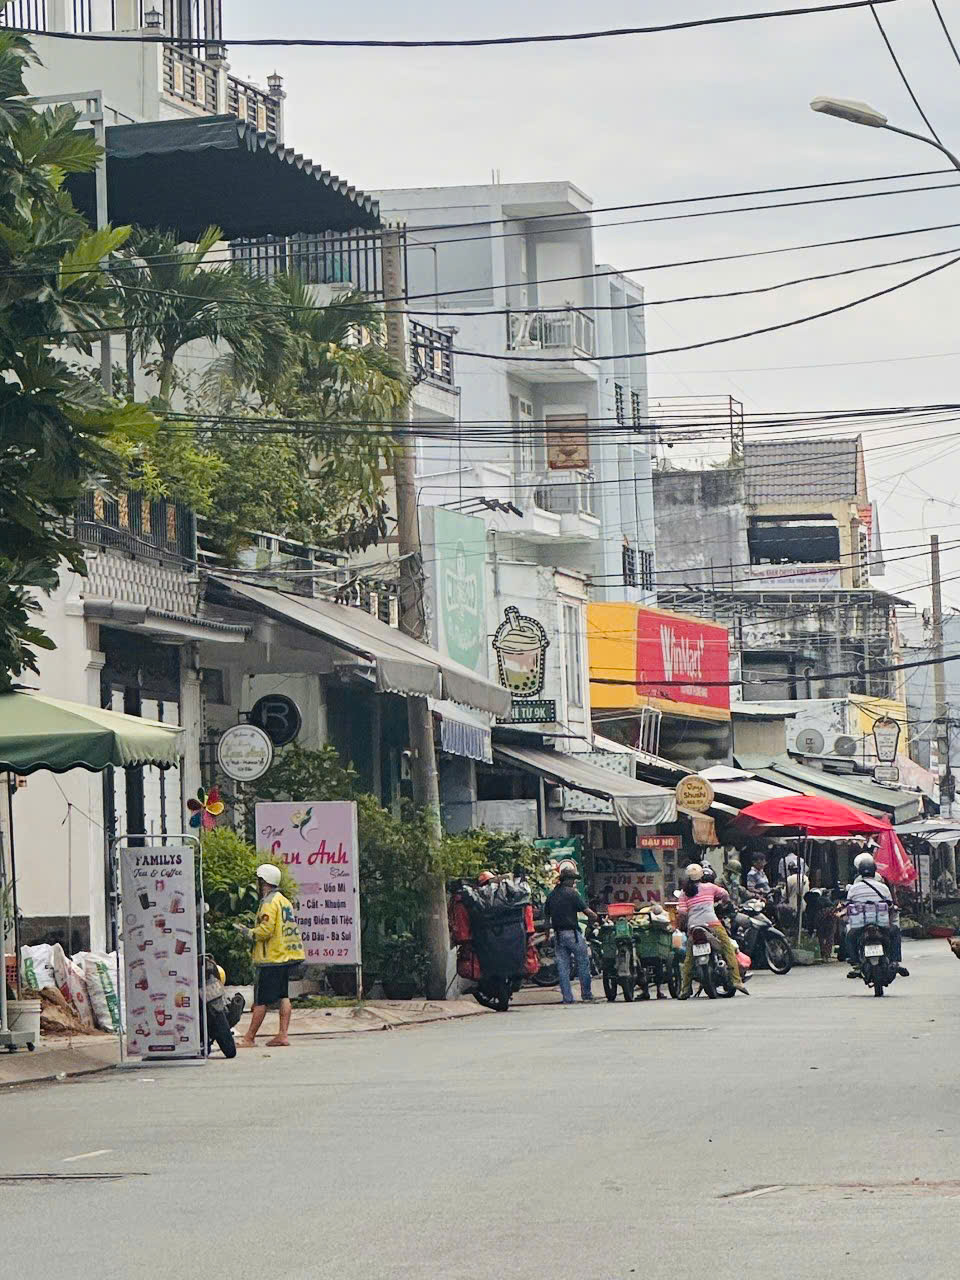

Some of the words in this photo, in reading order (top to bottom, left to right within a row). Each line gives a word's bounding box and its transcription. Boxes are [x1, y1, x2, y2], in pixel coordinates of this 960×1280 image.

[534, 706, 547, 718] 9K
[307, 840, 348, 865] Anh
[135, 855, 182, 866] FAMILYS
[133, 868, 147, 878] Tea
[150, 869, 158, 877] &
[160, 868, 182, 878] Coffee
[338, 883, 346, 892] Mi
[308, 949, 320, 957] 84
